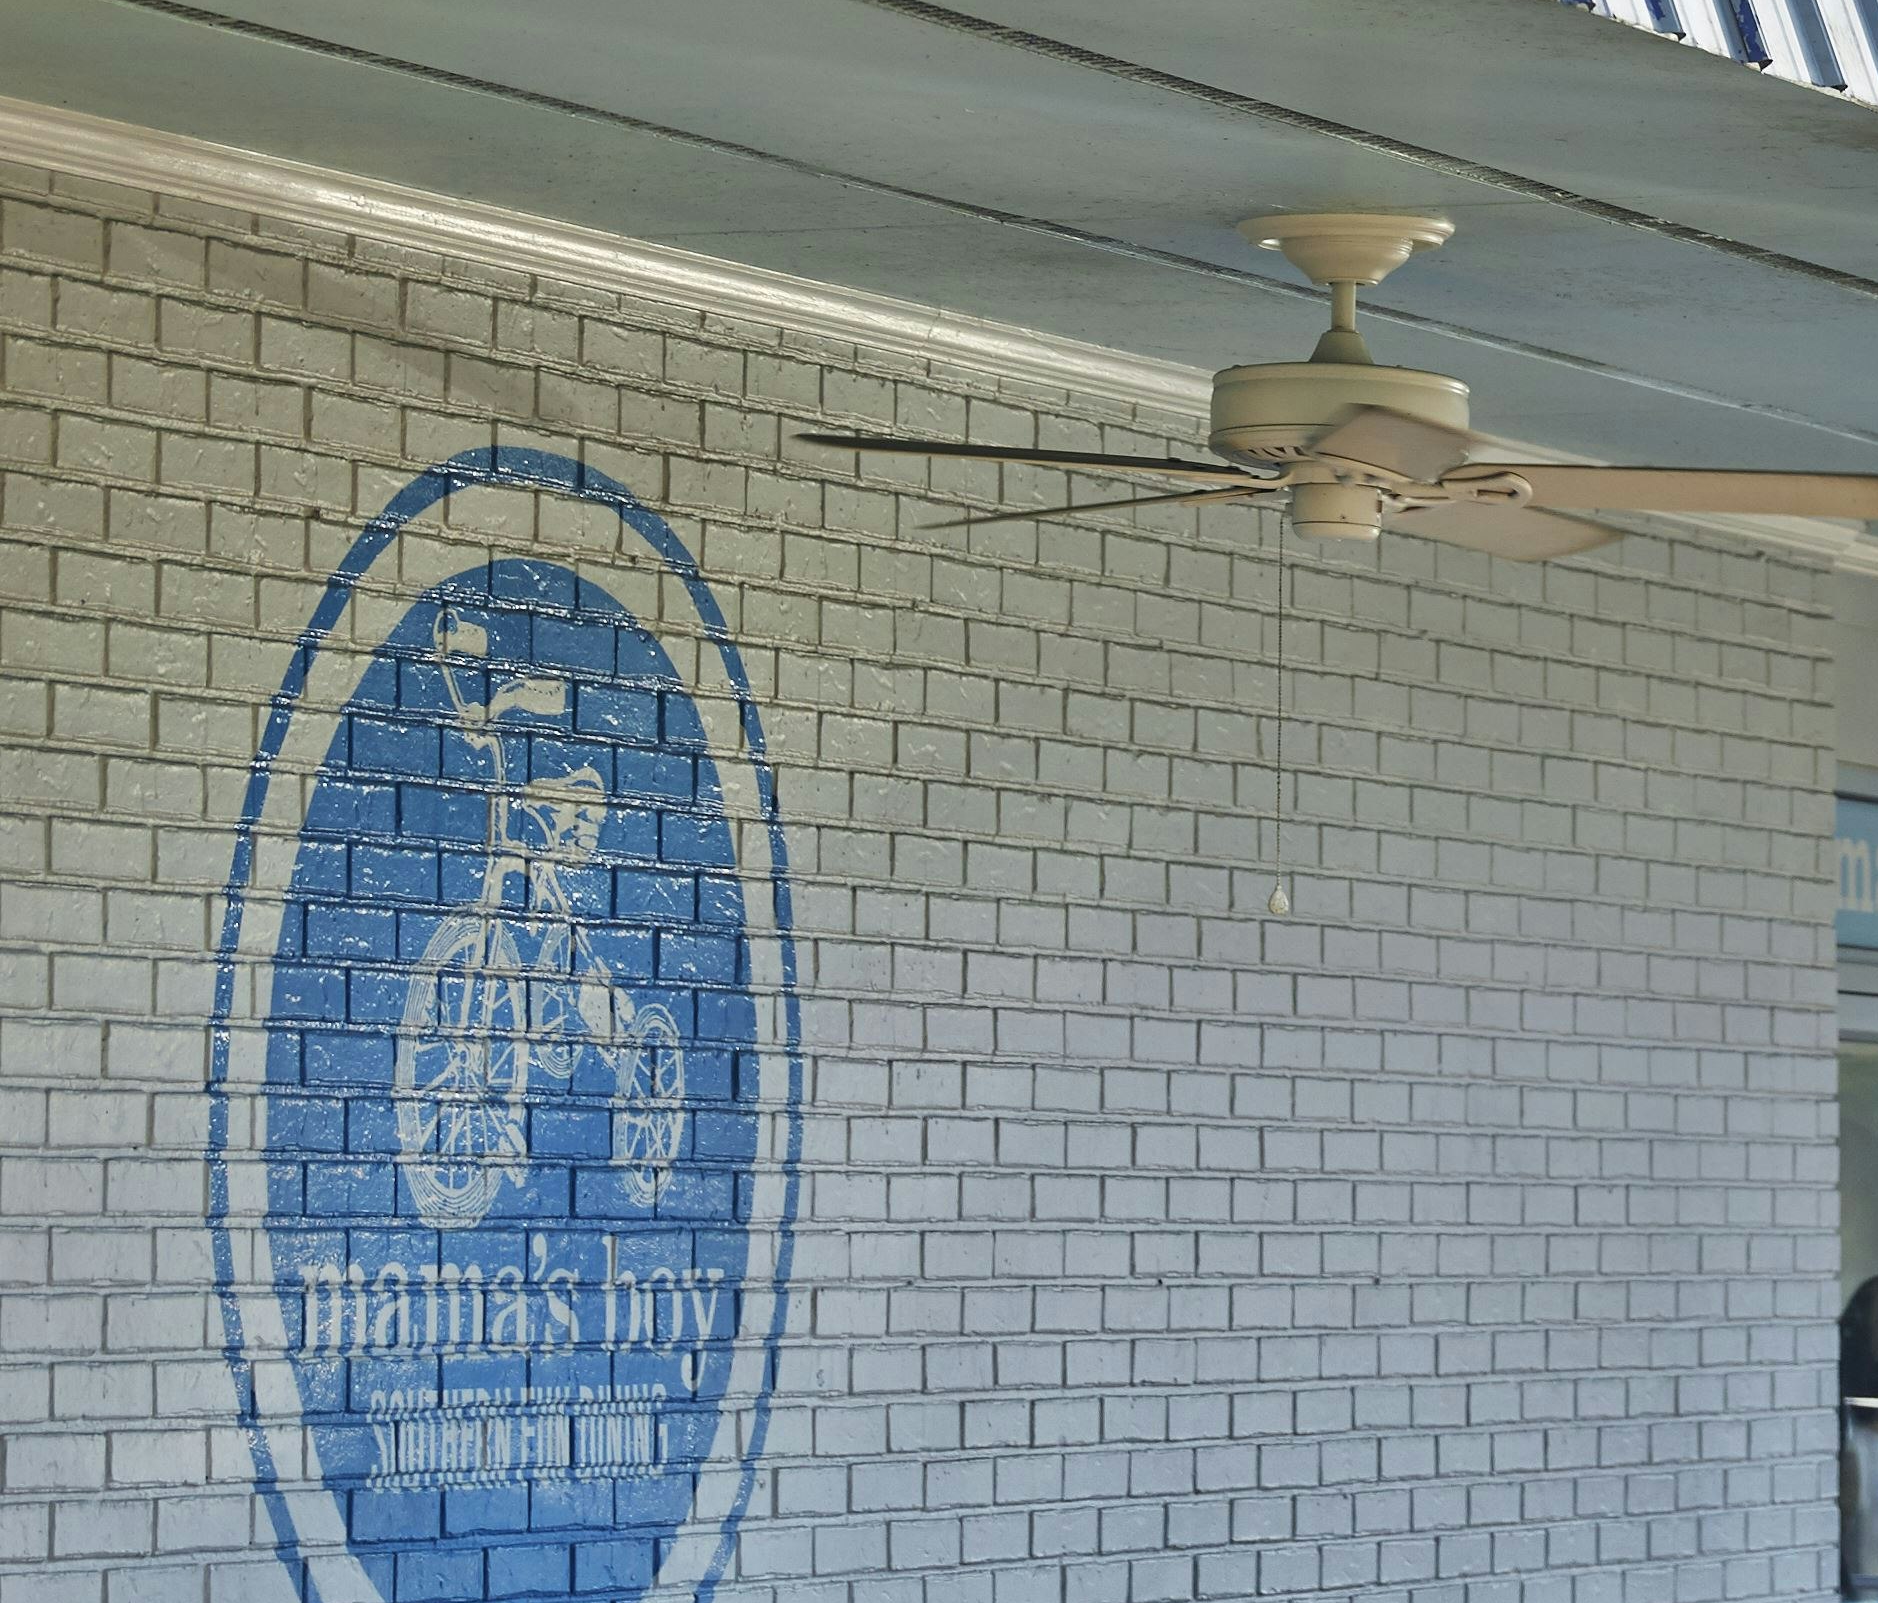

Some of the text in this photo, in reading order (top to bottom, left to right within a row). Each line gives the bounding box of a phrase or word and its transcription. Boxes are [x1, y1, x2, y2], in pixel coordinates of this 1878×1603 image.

[297, 1233, 726, 1392] mama's boy
[366, 1383, 668, 1493] SOUTHERN FUN DINING
